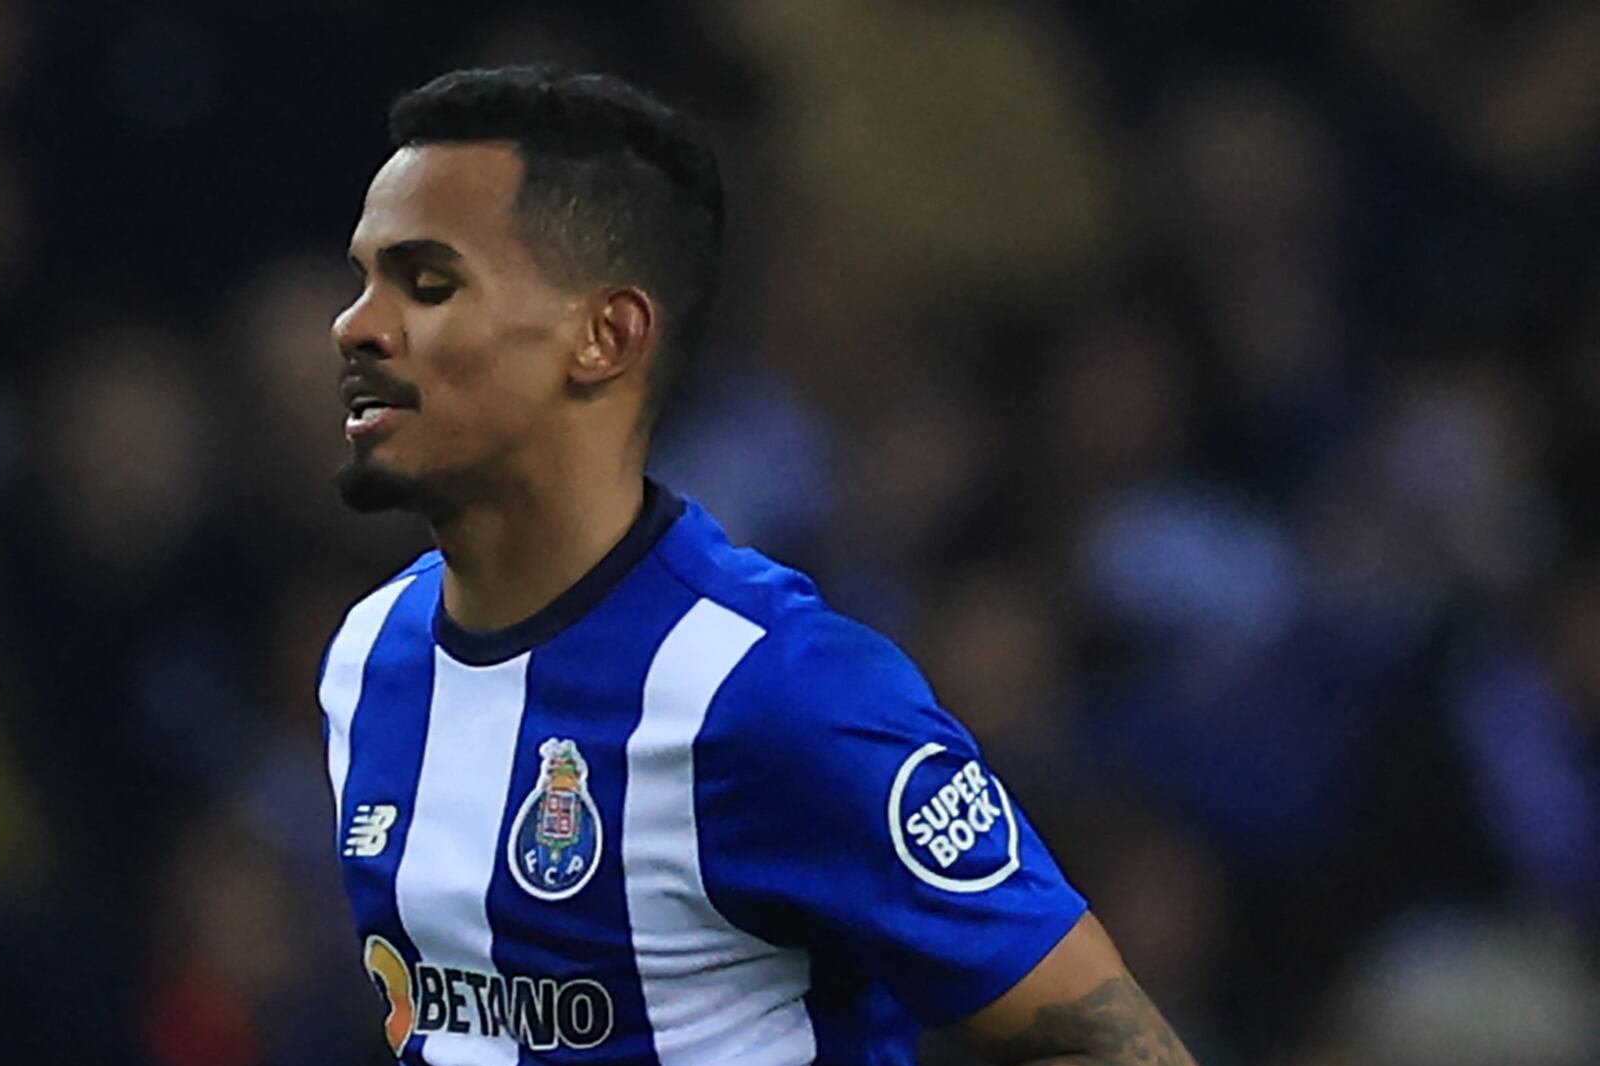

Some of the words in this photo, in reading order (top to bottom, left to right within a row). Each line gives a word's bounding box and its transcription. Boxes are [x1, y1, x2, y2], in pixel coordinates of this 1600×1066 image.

[906, 760, 988, 847] SUPER
[928, 789, 1000, 869] BOCK
[414, 962, 614, 1051] BETANO
